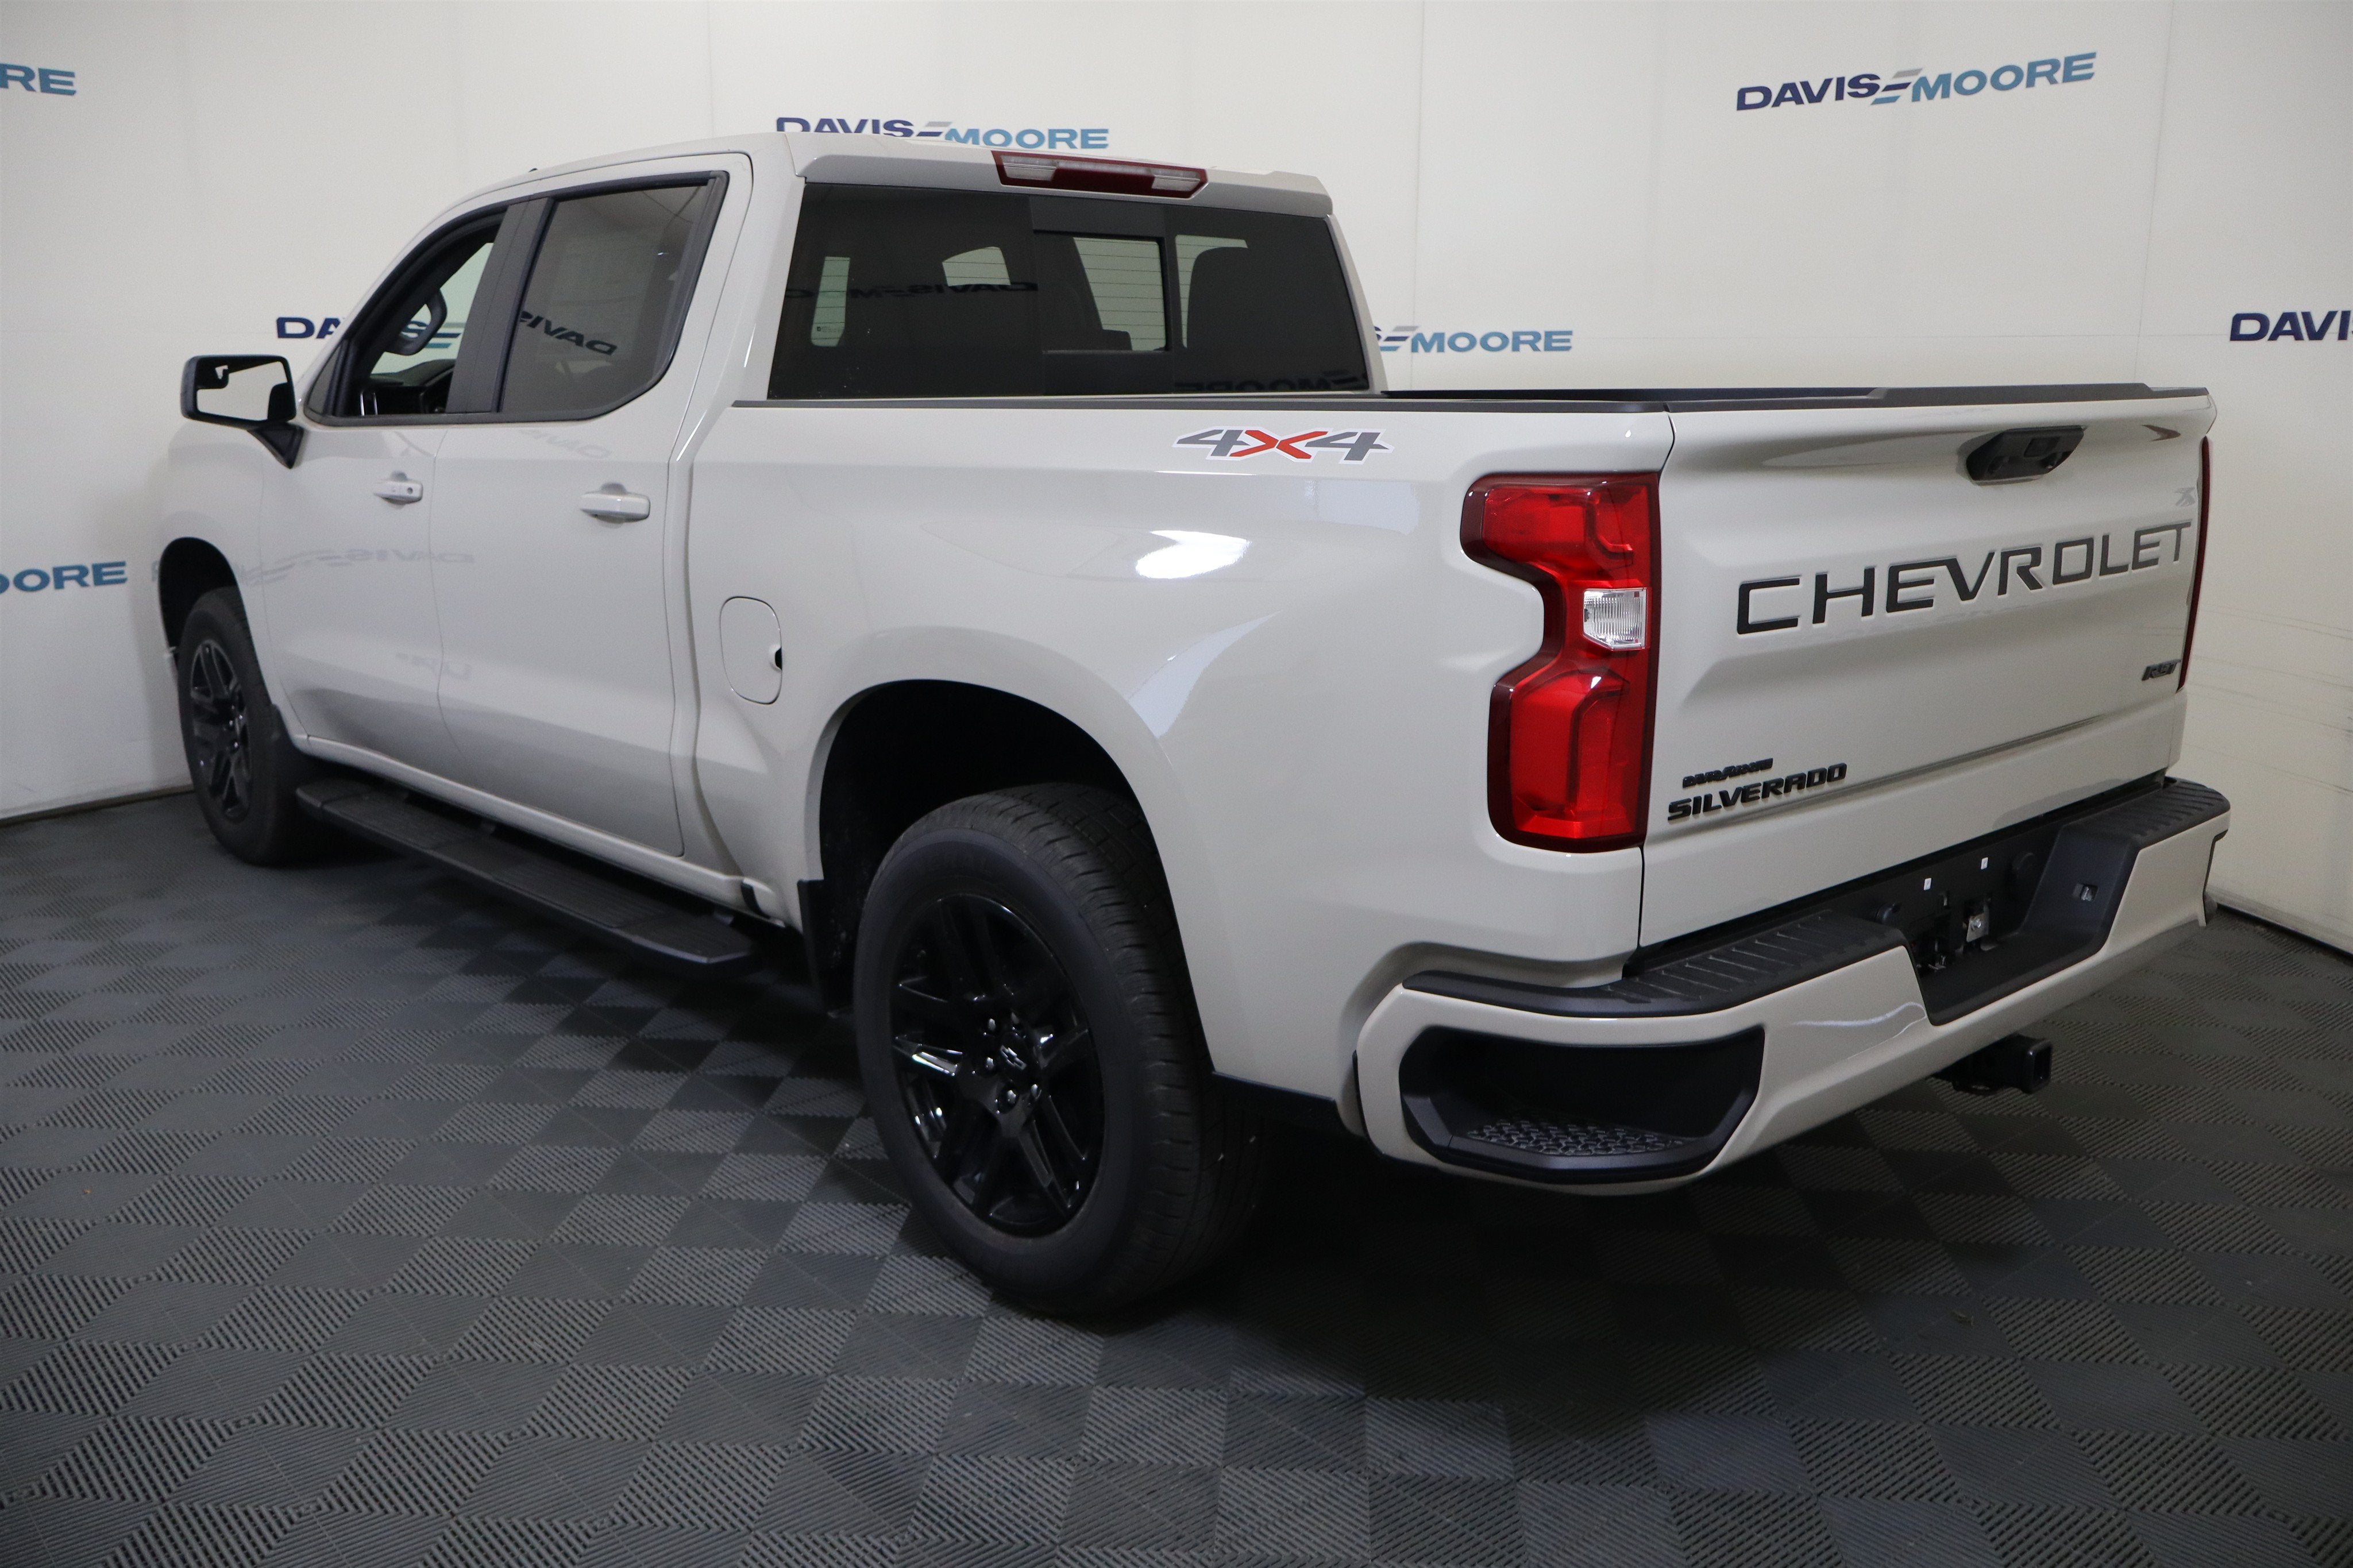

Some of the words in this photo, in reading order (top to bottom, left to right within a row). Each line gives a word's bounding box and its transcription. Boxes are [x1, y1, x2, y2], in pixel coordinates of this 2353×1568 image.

[1411, 330, 1573, 353] MOORE
[2229, 310, 2353, 341] DAVI
[0, 561, 128, 594] ORE
[1737, 521, 2193, 635] CHEVROLET
[1667, 763, 1847, 821] SILVERADO
